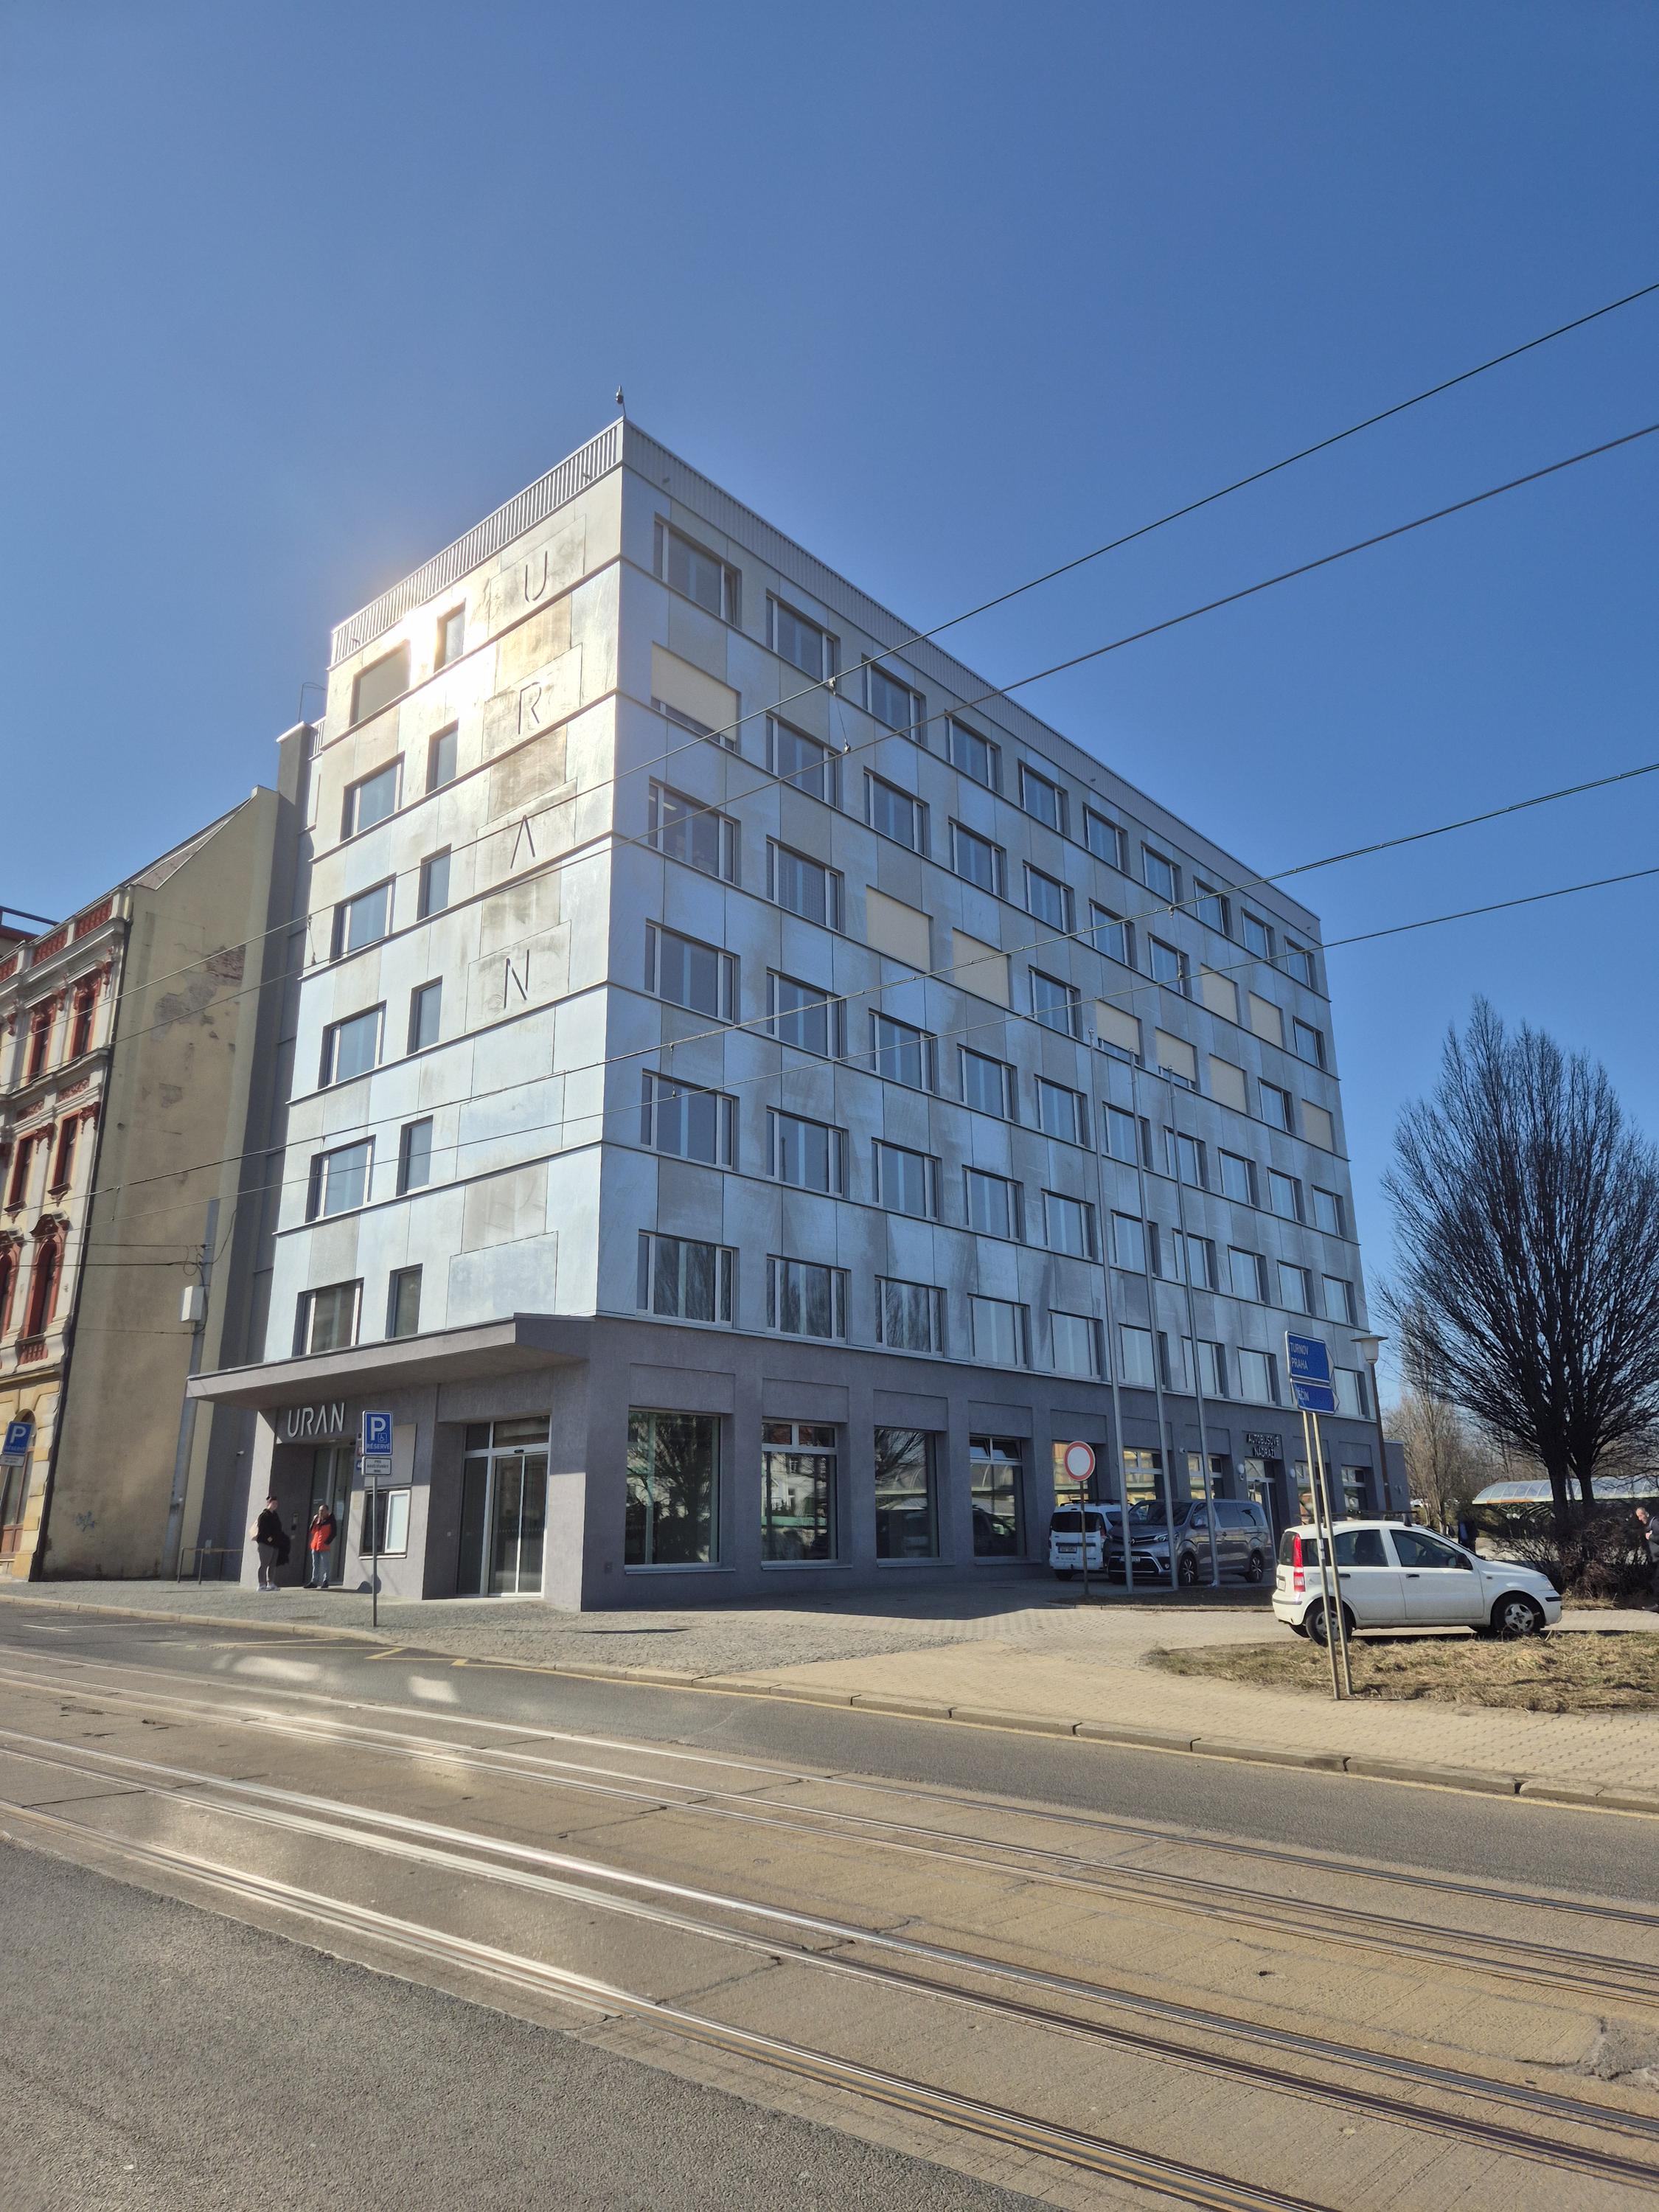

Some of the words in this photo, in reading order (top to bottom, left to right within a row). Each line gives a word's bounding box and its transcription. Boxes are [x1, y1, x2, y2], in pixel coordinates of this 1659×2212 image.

[1290, 1342, 1309, 1355] TURNOV
[1291, 1357, 1309, 1371] PRAHA
[1295, 1386, 1310, 1402] ĚČÍN
[287, 1402, 345, 1438] URAN
[9, 1425, 27, 1444] P
[370, 1416, 386, 1441] P
[1248, 1433, 1279, 1446] AUTOBUSOVÉ
